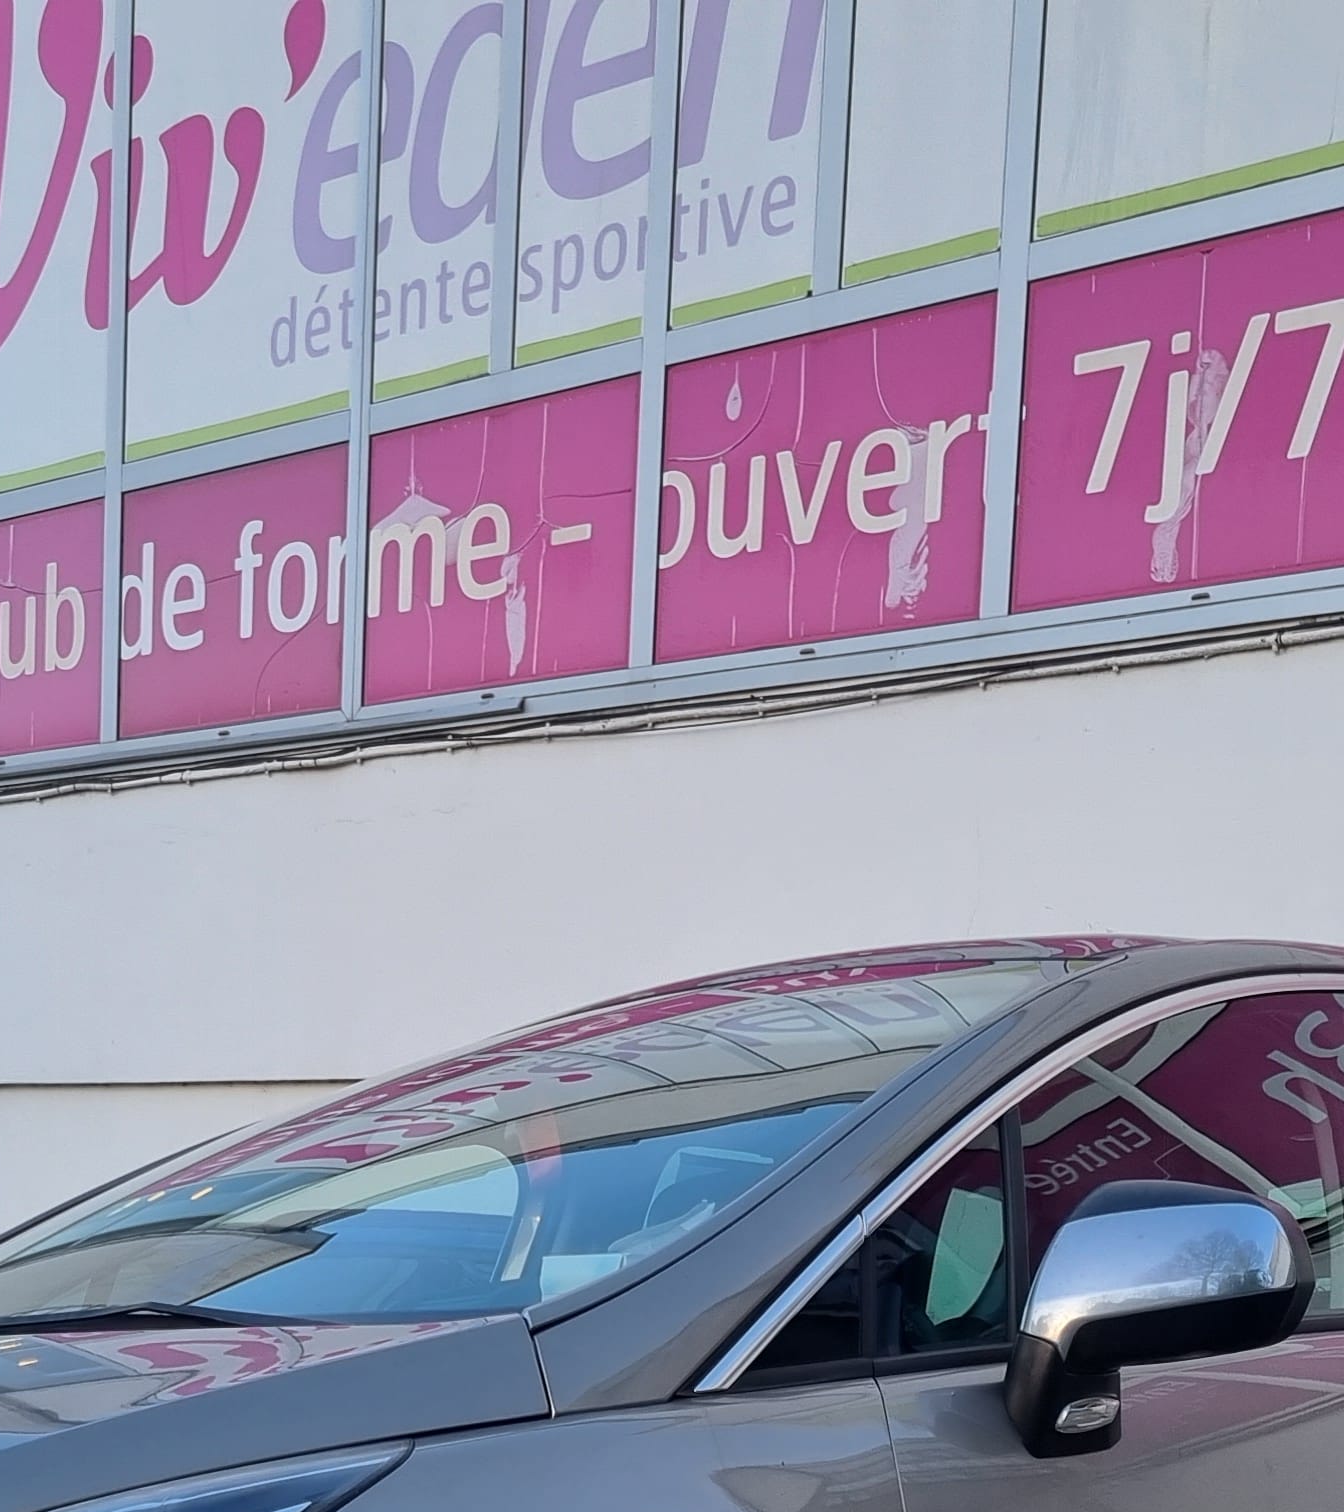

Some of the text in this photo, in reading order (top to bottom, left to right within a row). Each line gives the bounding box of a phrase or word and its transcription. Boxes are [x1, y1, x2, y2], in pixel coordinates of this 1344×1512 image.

[270, 173, 797, 368] détente sportive
[120, 541, 206, 660] de
[234, 502, 510, 639] forme
